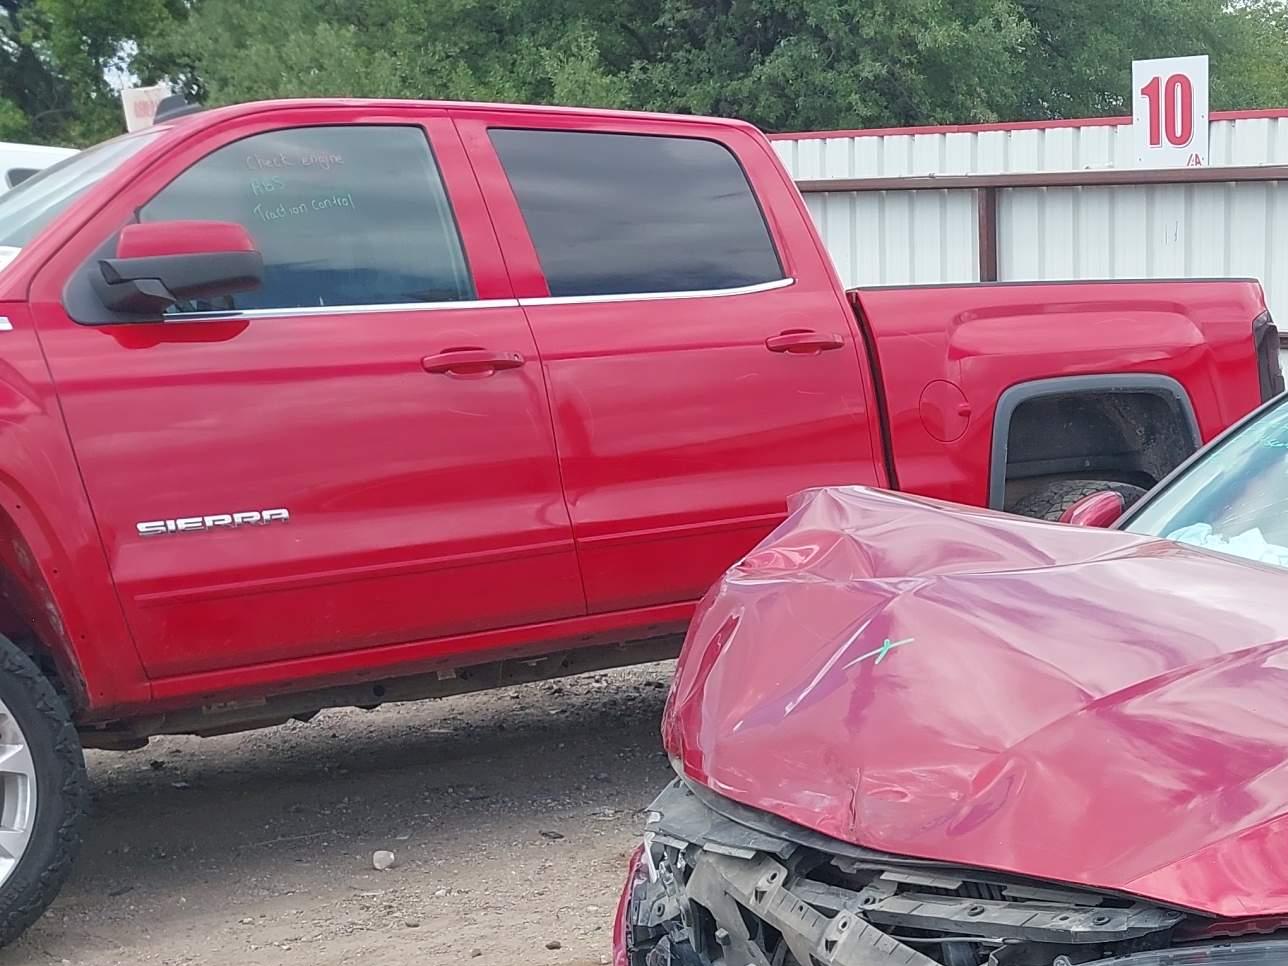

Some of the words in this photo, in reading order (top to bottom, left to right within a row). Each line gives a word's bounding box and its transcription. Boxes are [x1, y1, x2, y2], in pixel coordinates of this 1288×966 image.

[1140, 73, 1194, 148] 10
[246, 152, 289, 170] Check
[302, 152, 344, 171] engine
[136, 508, 290, 536] SIERRA
